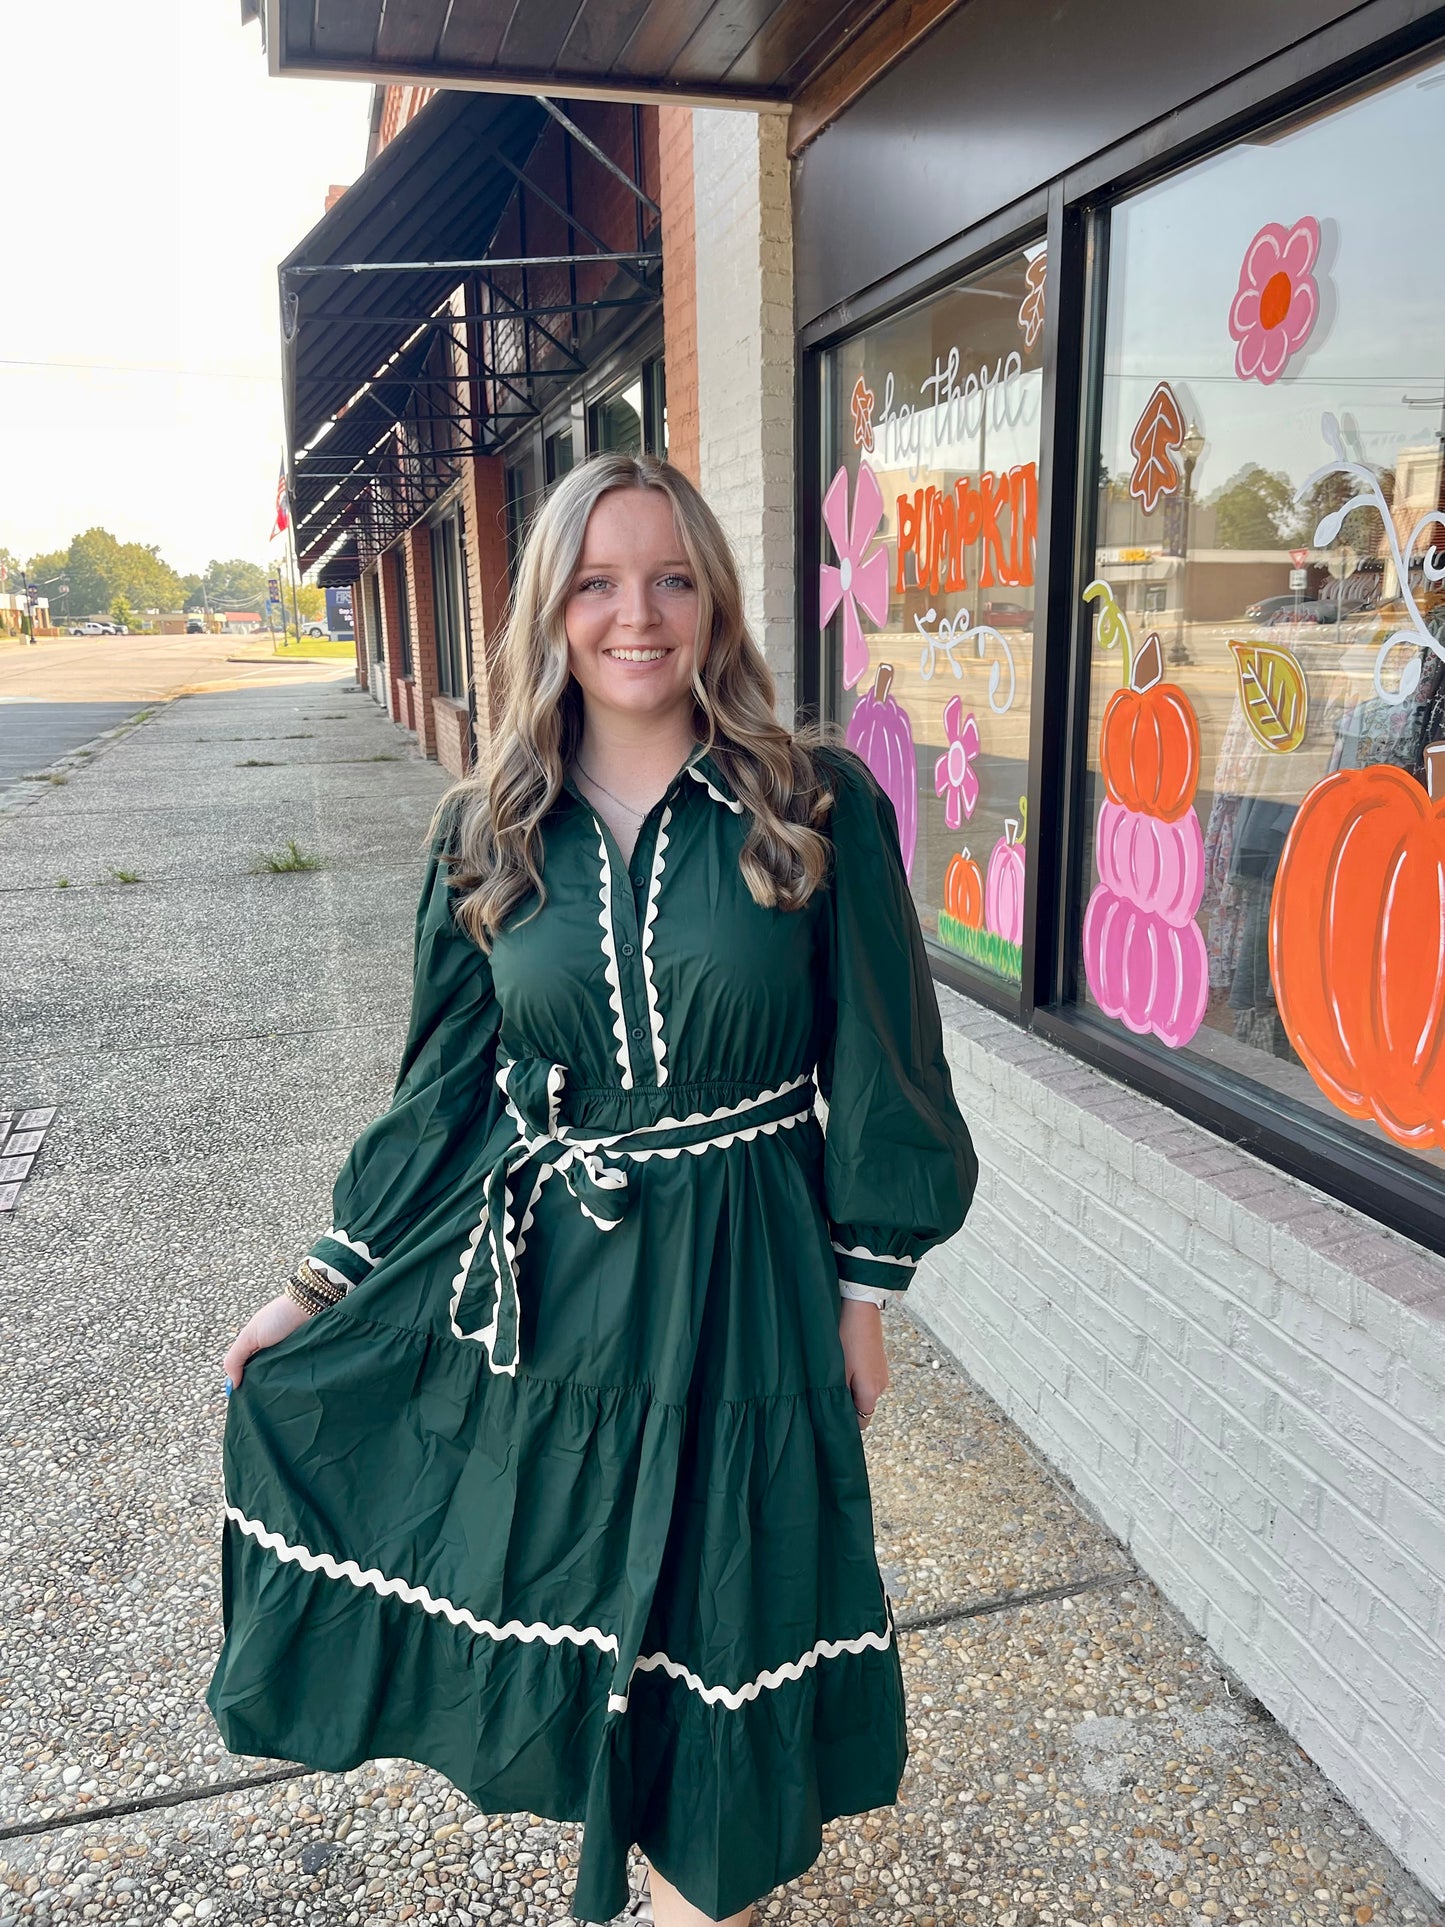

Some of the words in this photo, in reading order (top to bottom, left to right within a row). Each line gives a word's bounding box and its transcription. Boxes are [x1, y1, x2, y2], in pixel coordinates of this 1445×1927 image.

[880, 372, 920, 482] hey
[920, 347, 1028, 447] there
[896, 462, 1038, 595] PUMPKIN
